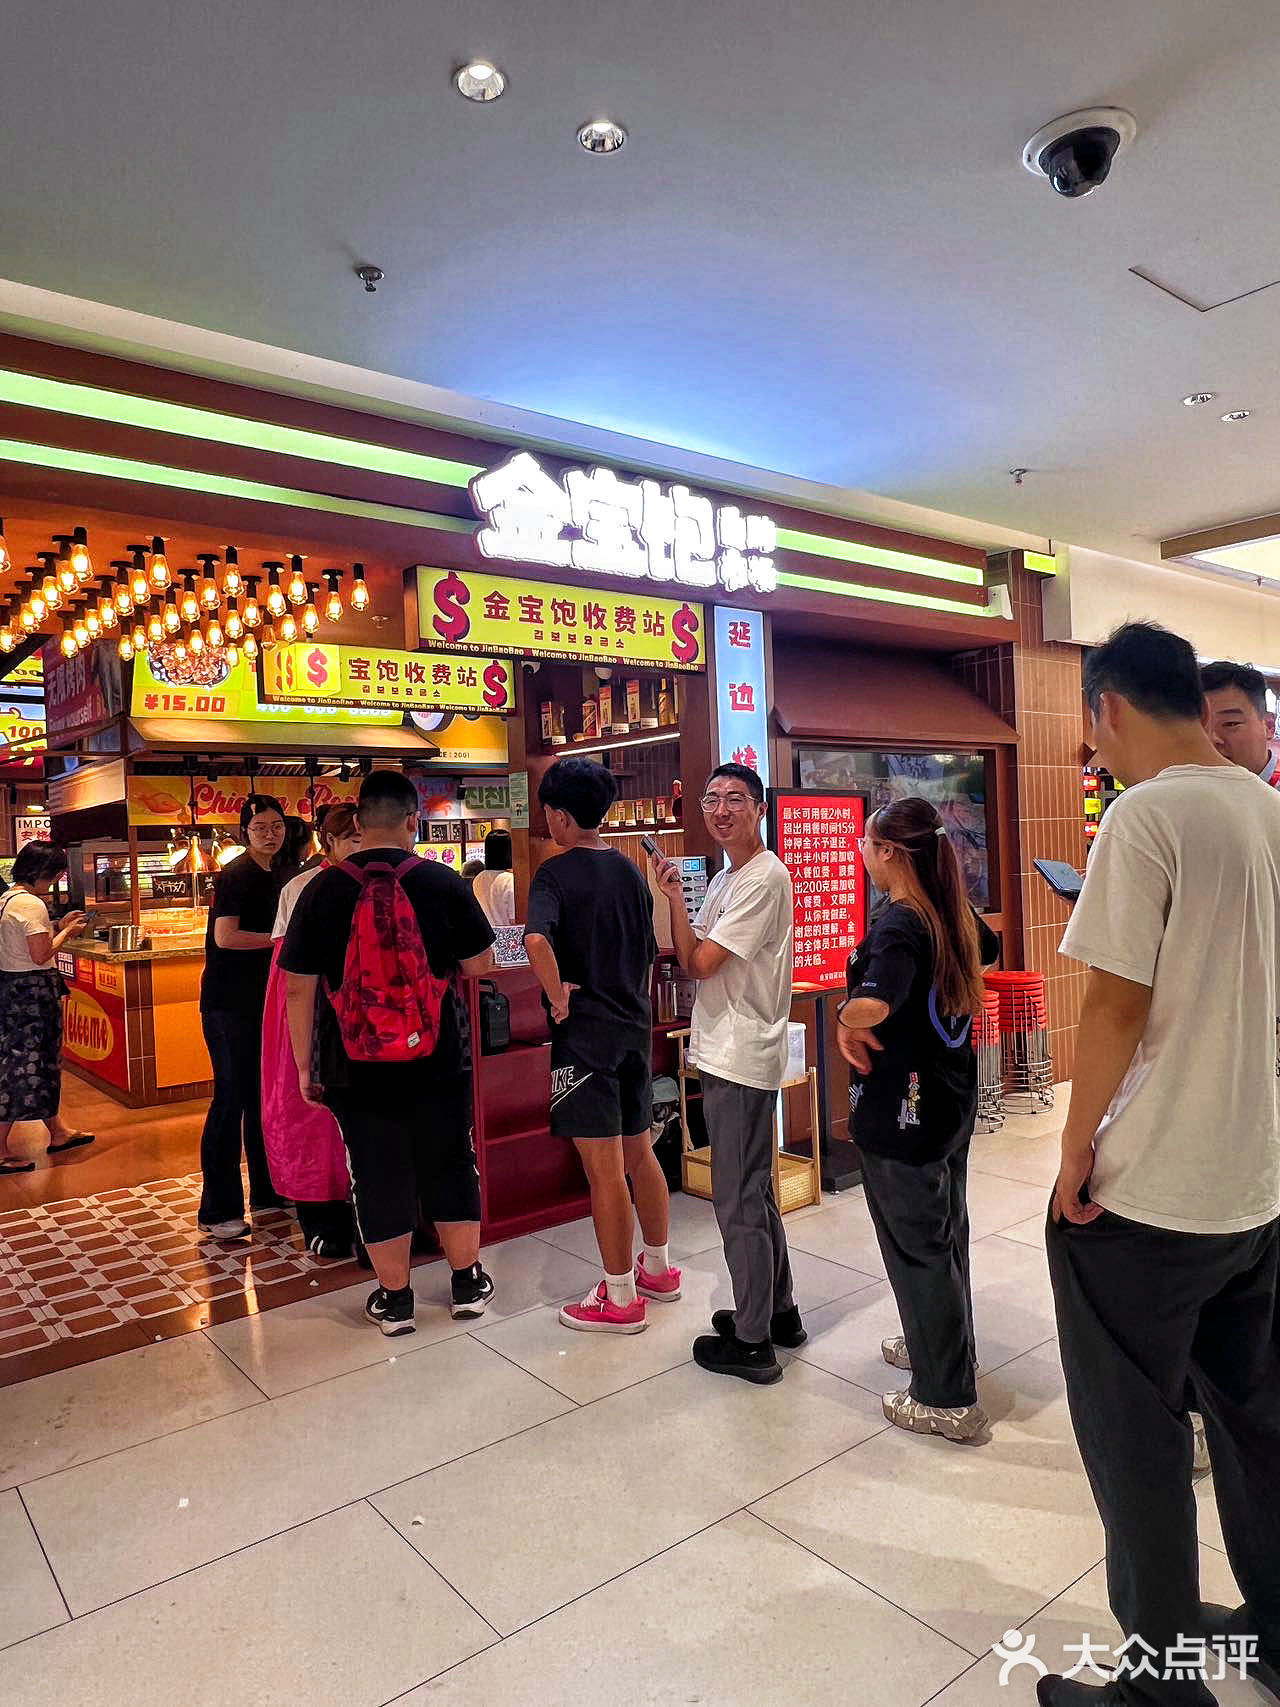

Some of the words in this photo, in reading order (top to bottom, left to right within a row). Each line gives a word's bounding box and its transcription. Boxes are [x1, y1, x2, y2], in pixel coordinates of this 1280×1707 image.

[483, 590, 665, 636] 金宝饱收费站
[427, 639, 468, 651] Welcome
[469, 643, 479, 652] to
[481, 644, 524, 656] JinBaoBao
[531, 648, 567, 660] Welcome
[568, 652, 577, 661] to
[578, 653, 618, 664] JinBaoBao
[622, 657, 655, 668] Welcome
[655, 660, 664, 669] to
[348, 657, 478, 688] 宝饱收费站
[144, 693, 225, 713] ¥15.00
[783, 822, 856, 835] 超出用餐时间15分
[794, 878, 856, 894] 出200克需加收
